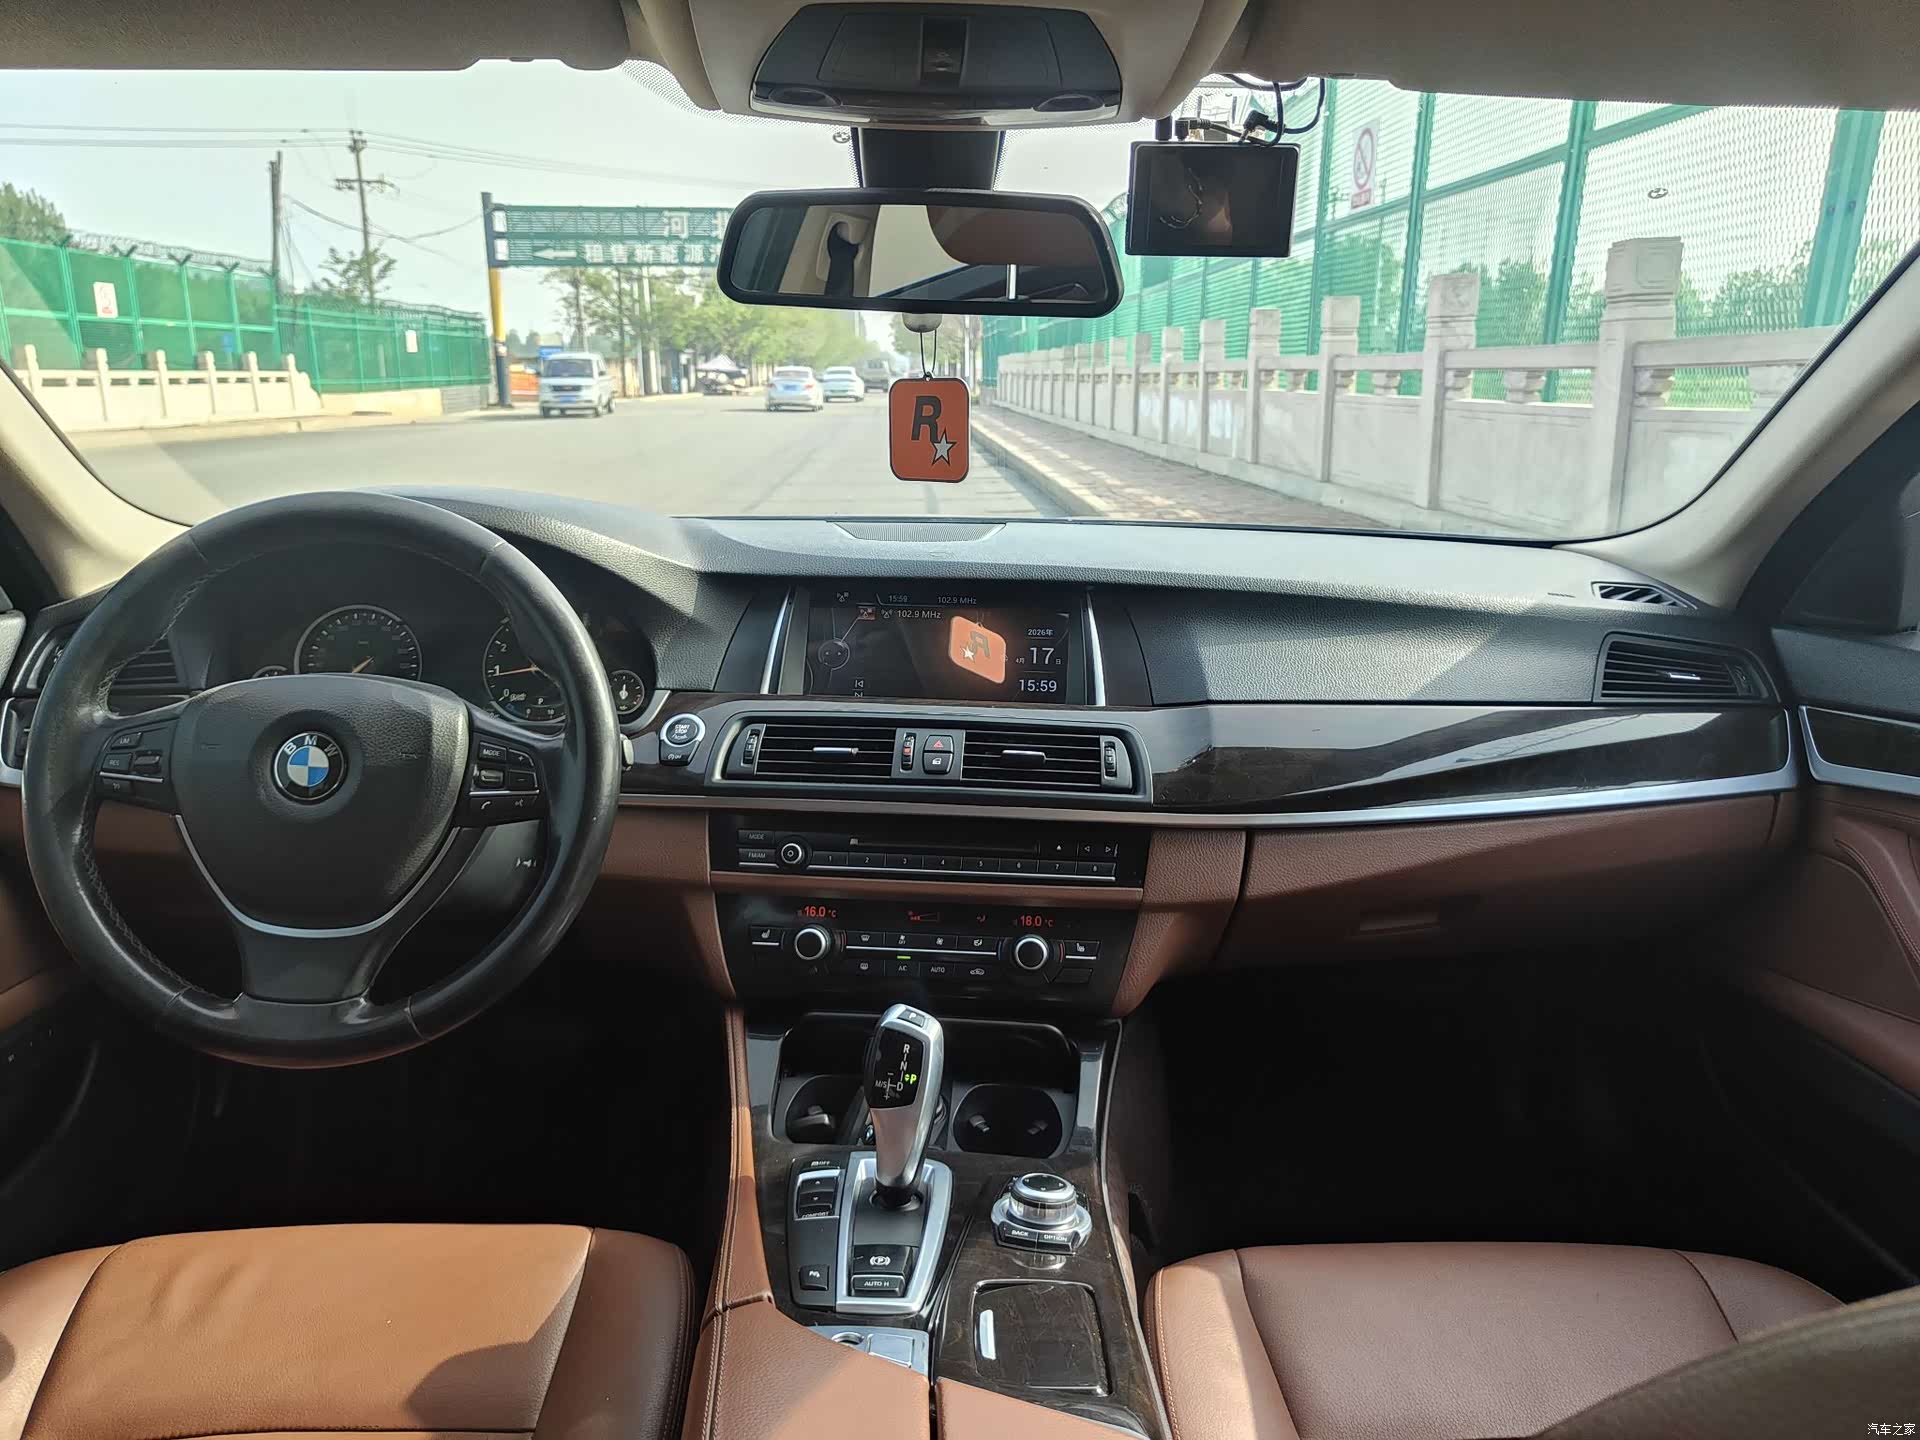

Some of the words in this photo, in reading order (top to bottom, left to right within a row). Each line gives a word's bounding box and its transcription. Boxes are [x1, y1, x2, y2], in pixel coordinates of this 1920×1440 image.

[911, 395, 942, 443] R
[888, 594, 908, 603] 15:59
[937, 596, 957, 604] 102.9
[959, 597, 977, 605] MHz
[897, 609, 920, 618] 102.9
[921, 610, 941, 619] MHz
[1027, 628, 1054, 636] 2026年
[500, 643, 507, 652] 2
[1019, 679, 1057, 692] 15:59
[283, 734, 340, 758] BMW
[483, 748, 501, 757] MODE
[804, 906, 826, 918] 16.0
[1020, 915, 1042, 927] 18.0
[903, 1044, 910, 1053] R
[900, 1061, 907, 1071] N
[910, 1074, 917, 1084] P
[897, 1081, 904, 1091] D
